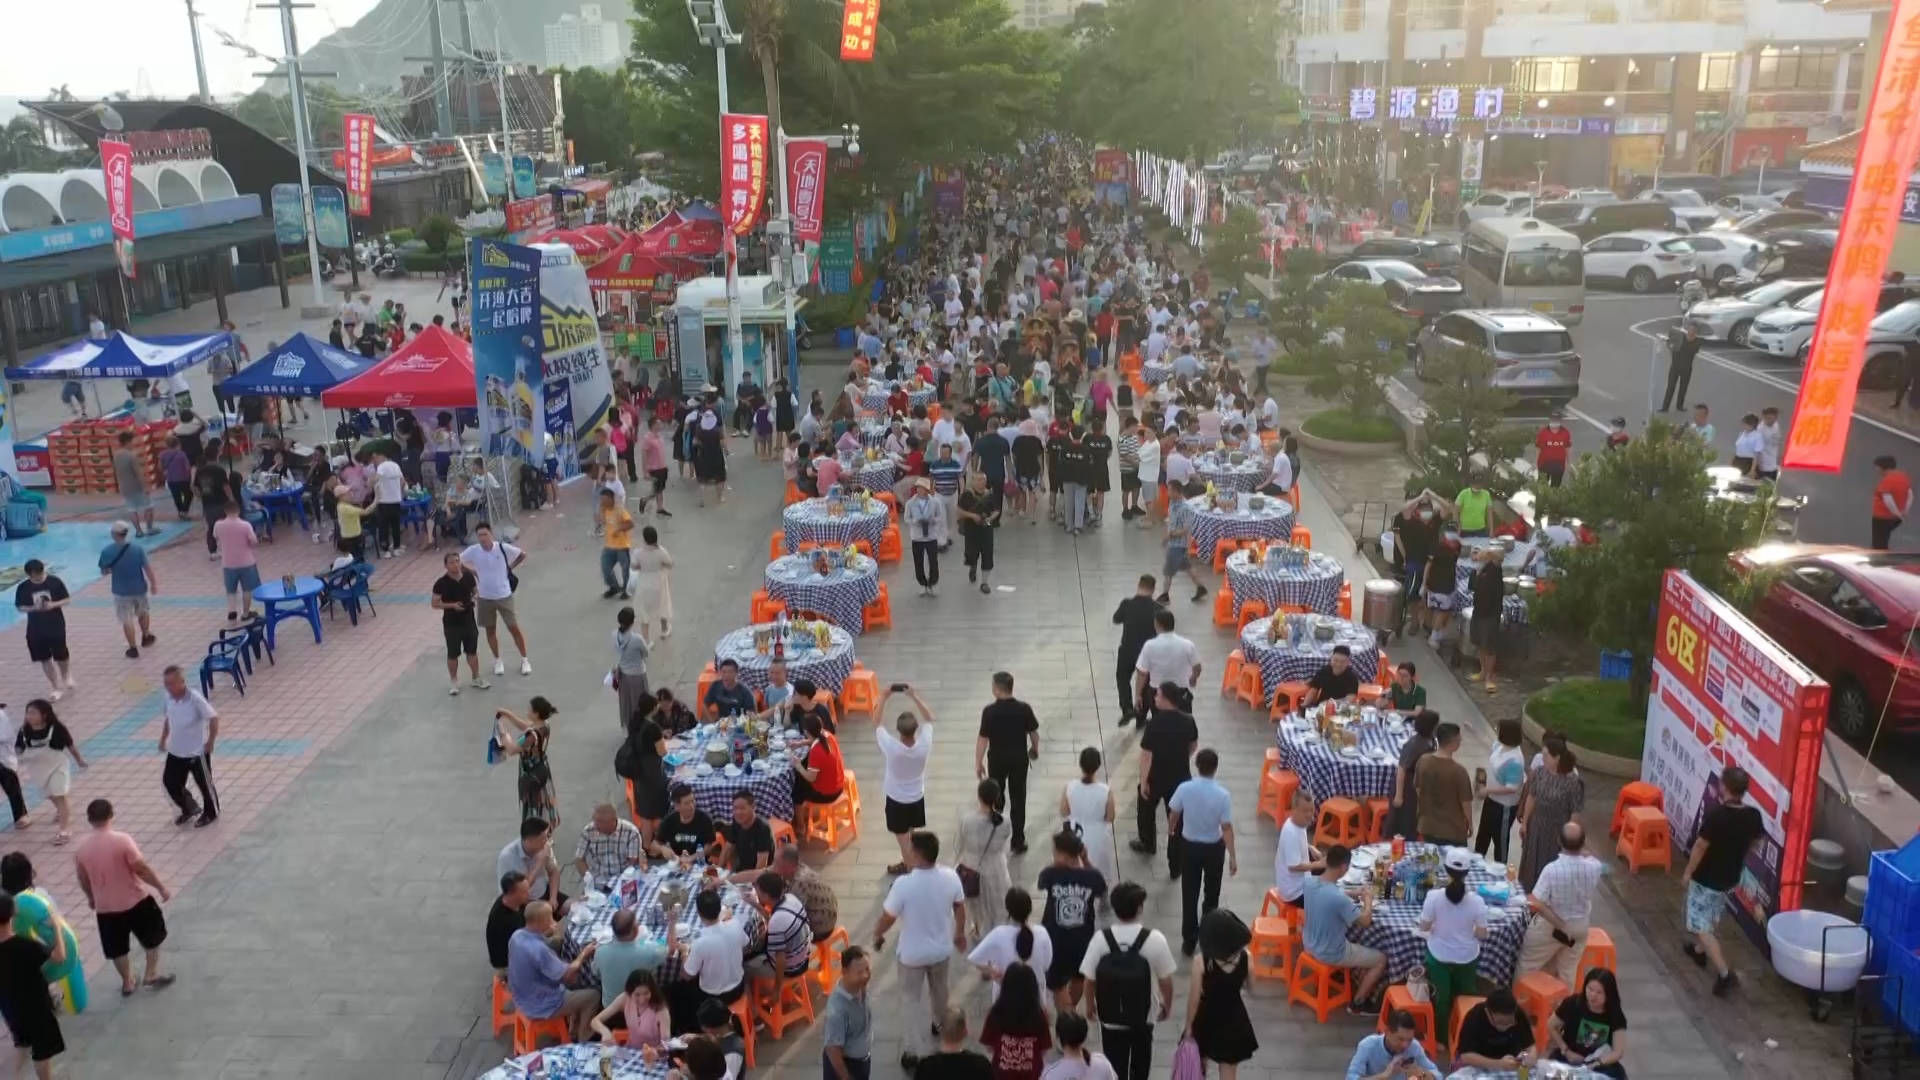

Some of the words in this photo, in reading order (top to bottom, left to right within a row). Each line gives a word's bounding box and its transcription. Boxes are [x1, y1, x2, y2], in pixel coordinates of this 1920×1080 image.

[1348, 86, 1504, 120] 碧源渔村
[479, 286, 532, 310] 开渔大吉
[479, 307, 533, 329] 一起哈啤
[1665, 615, 1698, 675] 6区
